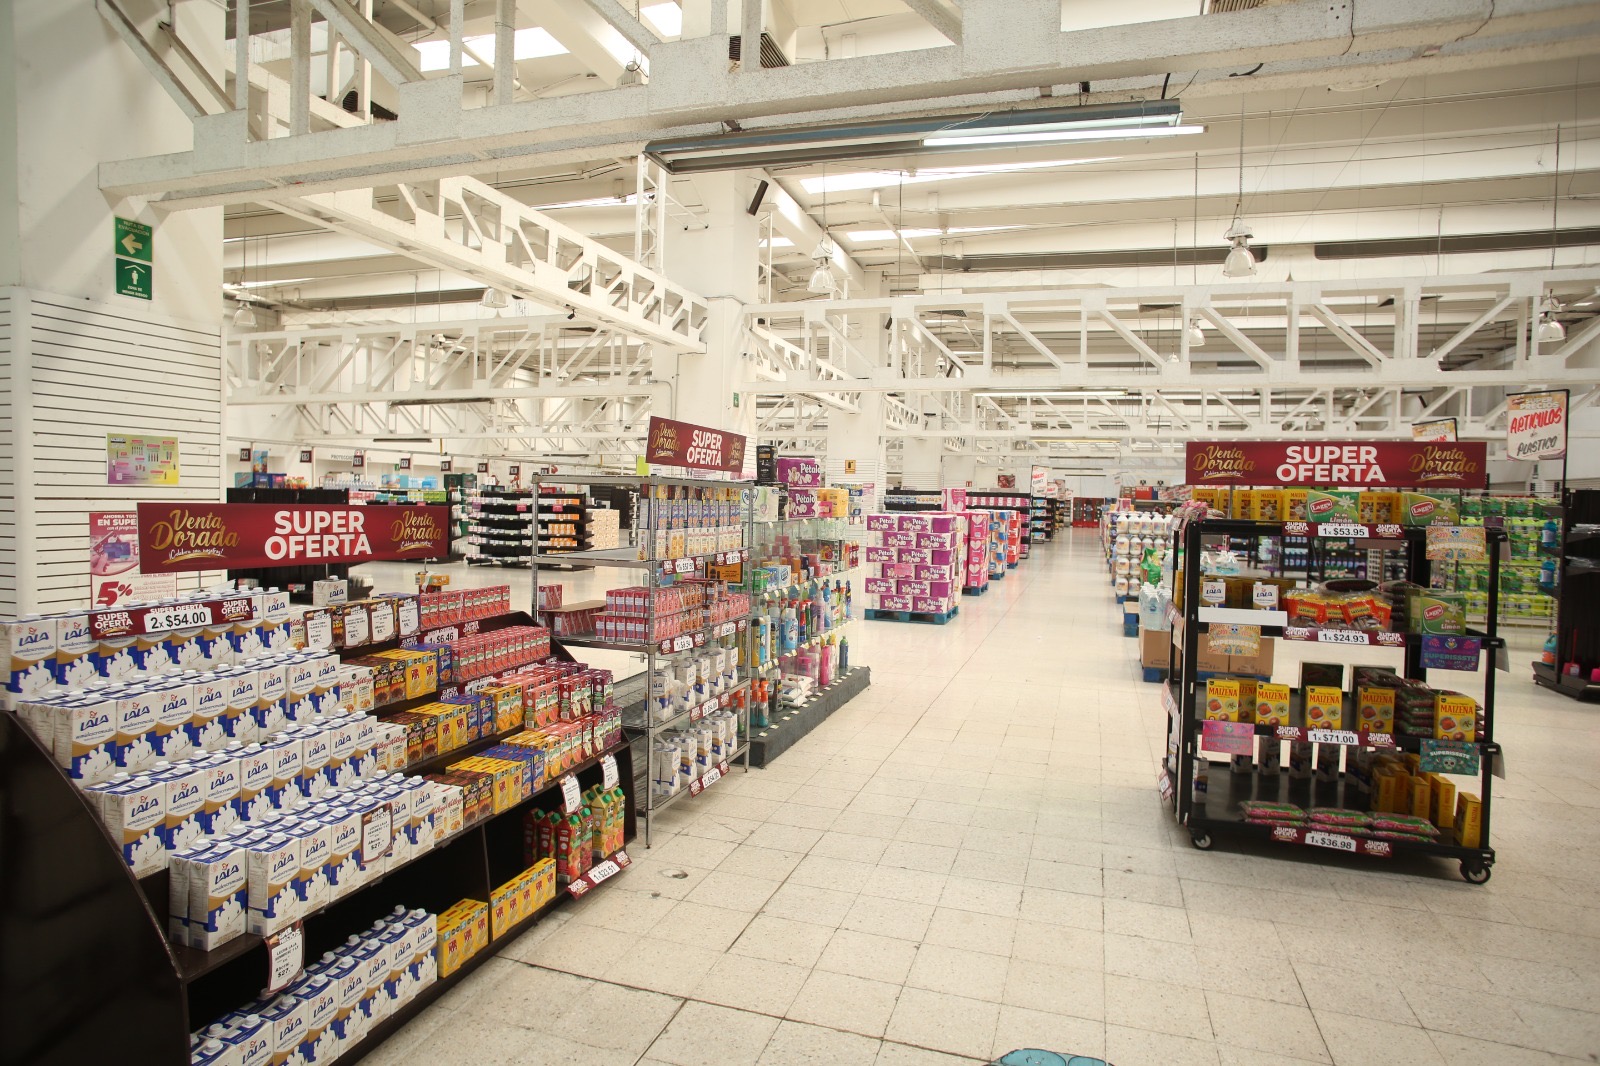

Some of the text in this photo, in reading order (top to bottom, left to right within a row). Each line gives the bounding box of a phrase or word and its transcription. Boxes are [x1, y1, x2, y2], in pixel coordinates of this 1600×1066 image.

[1520, 402, 1560, 410] PRECIOS
[1510, 407, 1562, 434] ARTICULOS
[660, 423, 677, 438] Venta
[651, 430, 680, 451] Dorada
[692, 430, 722, 450] SUPER
[1517, 436, 1558, 456] PLASTICO
[687, 446, 722, 466] OFERTA
[1206, 445, 1243, 459] Venta
[1286, 446, 1377, 464] SUPER
[1424, 446, 1464, 460] Venta
[1193, 453, 1256, 471] Dorada
[1408, 453, 1478, 473] Dorada
[1276, 464, 1386, 482] OFERTA
[113, 518, 137, 526] SUPE
[170, 509, 222, 532] Venta
[274, 510, 365, 534] SUPER
[402, 510, 434, 528] Venta
[149, 521, 240, 551] Dorada
[391, 520, 443, 543] Dorada
[1333, 527, 1365, 536] $53.95
[264, 533, 372, 560] OFERTA
[96, 580, 133, 606] 5%
[329, 589, 344, 598] LALA
[267, 601, 286, 613] LALA
[94, 618, 133, 629] OFERTA
[97, 612, 129, 622] SUPER
[166, 611, 206, 628] $54.00
[19, 632, 49, 646] LALA
[65, 626, 90, 640] LALA
[1333, 634, 1365, 643] $24.93
[294, 671, 312, 683] LALA
[319, 665, 336, 677] LALA
[232, 683, 253, 697] LALA
[264, 676, 282, 689] LALA
[199, 691, 222, 704] LALA
[1208, 687, 1238, 697] MAIZENA
[1258, 691, 1288, 701] MAIZENA
[1309, 694, 1340, 704] MAIZENA
[1362, 694, 1393, 704] MAIZENA
[123, 705, 150, 721] LALA
[162, 698, 188, 712] LALA
[1440, 704, 1474, 714] MAIZENA
[80, 714, 109, 731] LALA
[335, 735, 352, 748] LALA
[358, 727, 373, 740] LALA
[1323, 734, 1354, 743] $71.00
[309, 743, 326, 758] LALA
[278, 753, 298, 768] LALA
[247, 762, 268, 778] LALA
[210, 773, 234, 790] LALA
[172, 785, 199, 803] LALA
[415, 793, 430, 807] LALA
[131, 798, 159, 817] LALA
[393, 803, 407, 817] ALA
[336, 827, 356, 844] LALA
[1320, 838, 1352, 849] $36.98
[306, 840, 326, 857] LALA
[273, 853, 294, 873] LALA
[215, 864, 240, 885] LALA
[417, 927, 433, 943] LALA
[394, 942, 411, 960] LALA
[369, 959, 387, 978] LALA
[343, 977, 362, 997] LALA
[313, 997, 334, 1018] LALA
[280, 1017, 303, 1041] LALA
[242, 1040, 267, 1064] LALA
